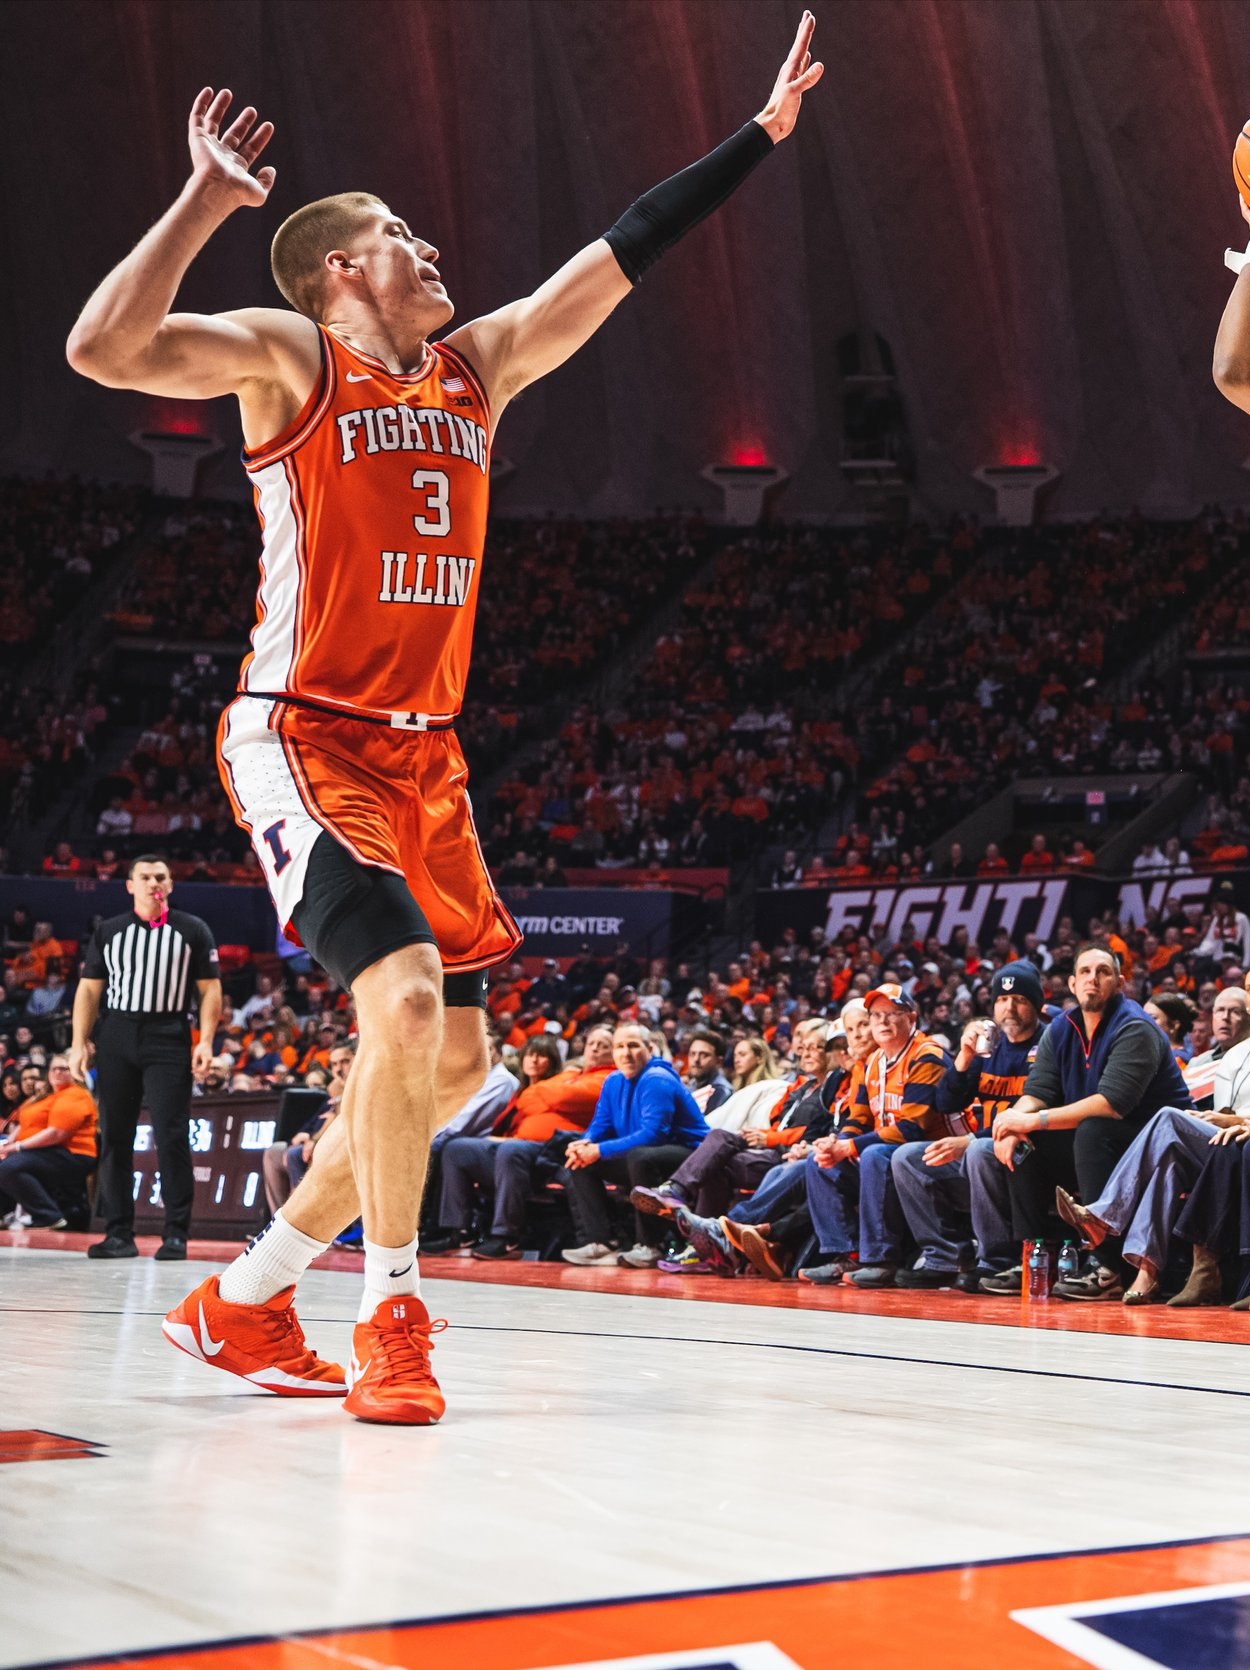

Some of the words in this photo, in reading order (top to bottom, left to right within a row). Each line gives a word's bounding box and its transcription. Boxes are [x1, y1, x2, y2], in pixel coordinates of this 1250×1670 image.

[336, 403, 488, 476] FIGHTING
[411, 468, 451, 537] 3
[262, 818, 293, 878] I
[550, 916, 620, 935] CENTER
